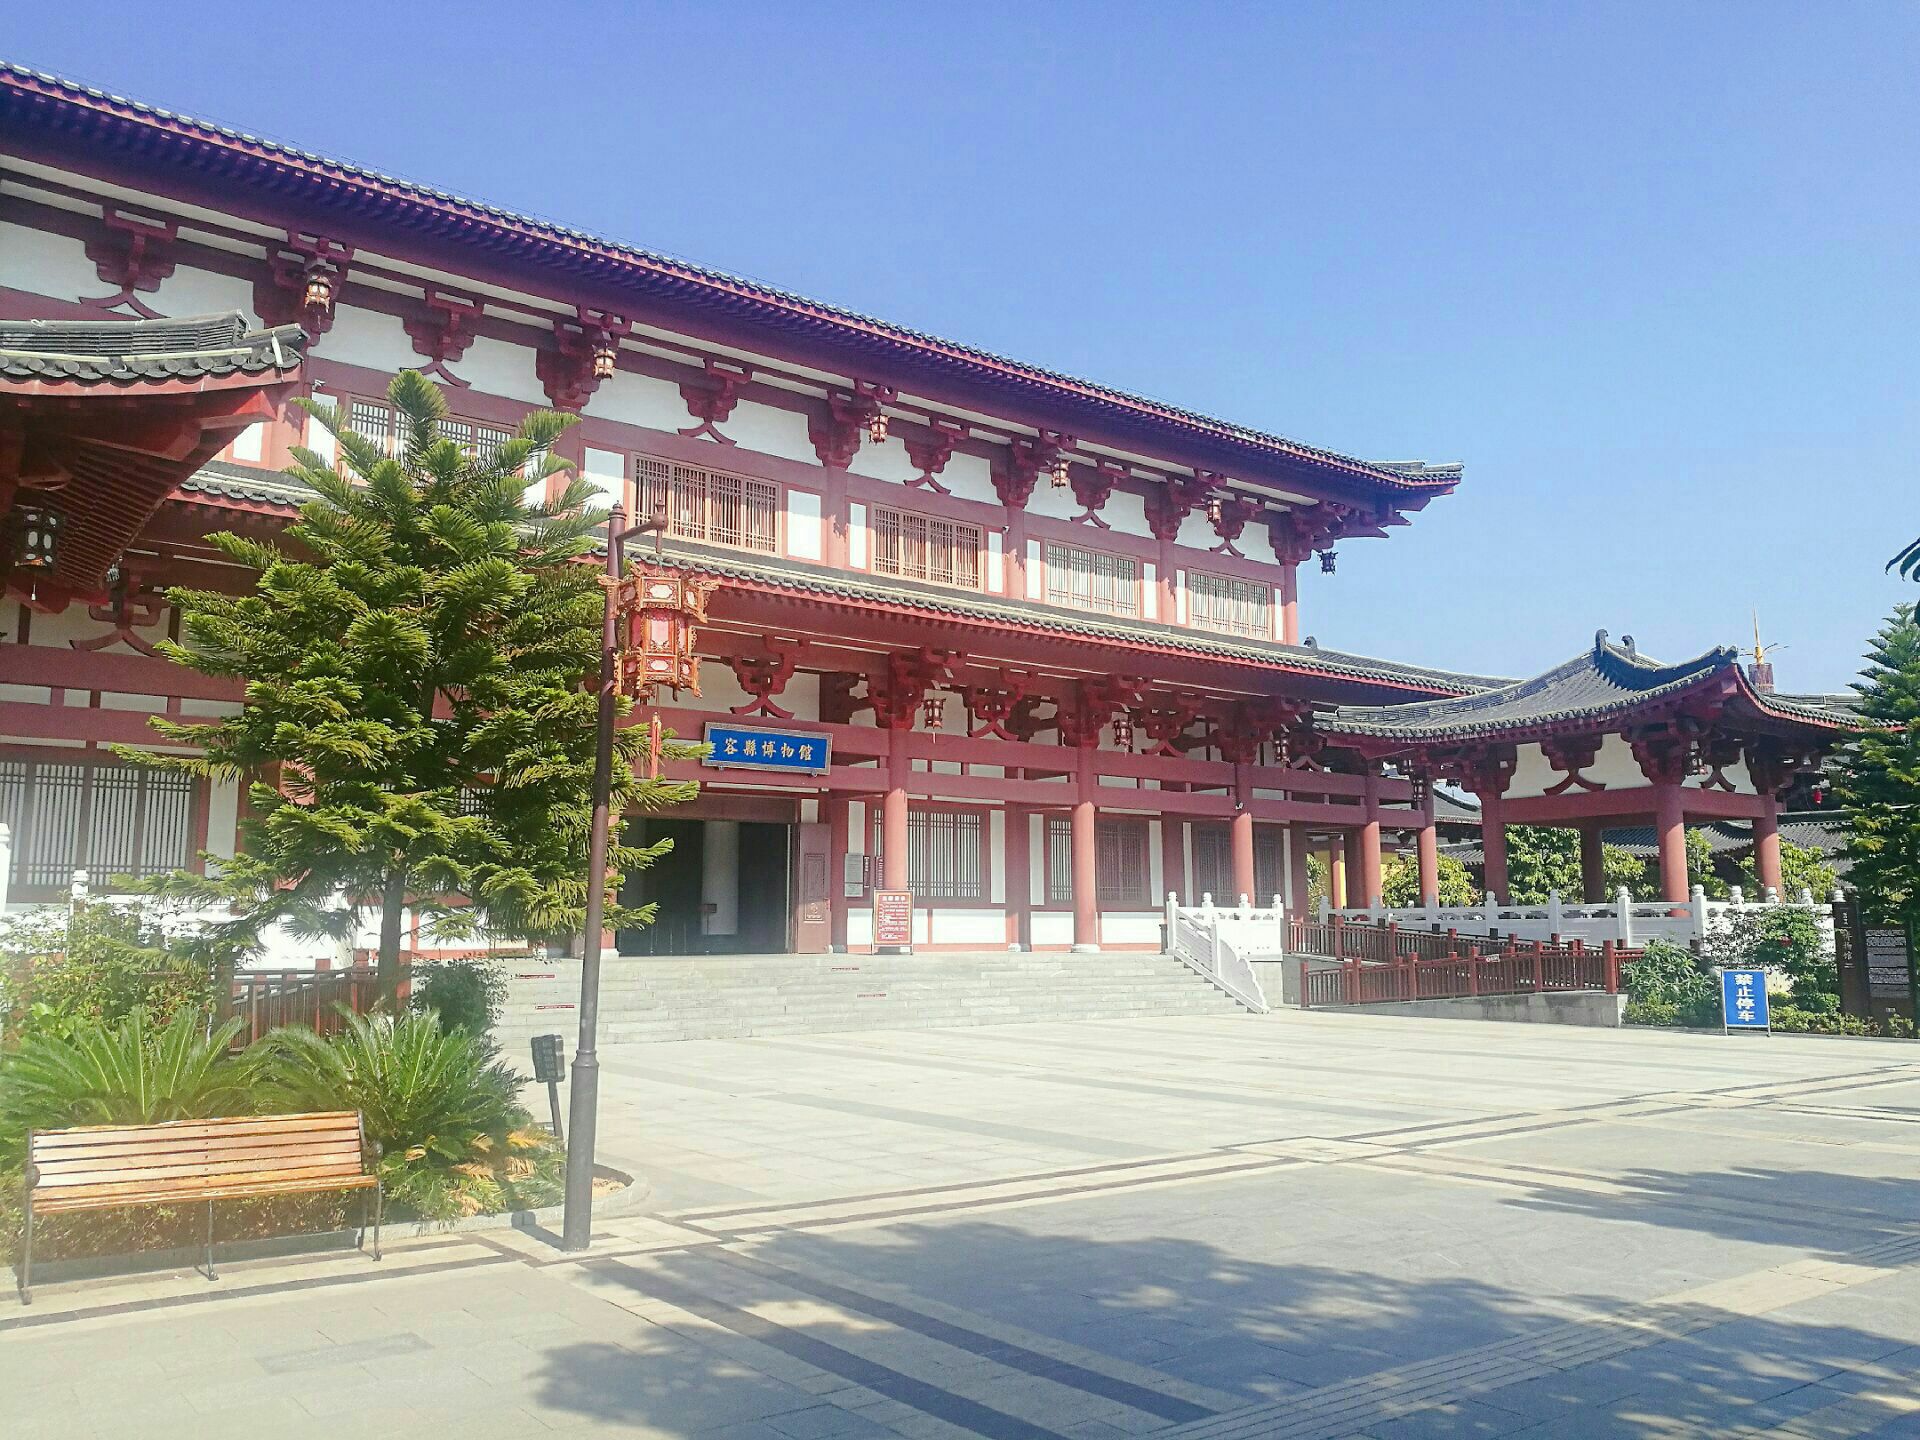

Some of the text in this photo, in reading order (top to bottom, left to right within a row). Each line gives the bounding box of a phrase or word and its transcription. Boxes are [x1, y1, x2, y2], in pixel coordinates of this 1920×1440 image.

[724, 737, 814, 760] 容縣博物館
[1735, 973, 1755, 1022] 禁止停车
